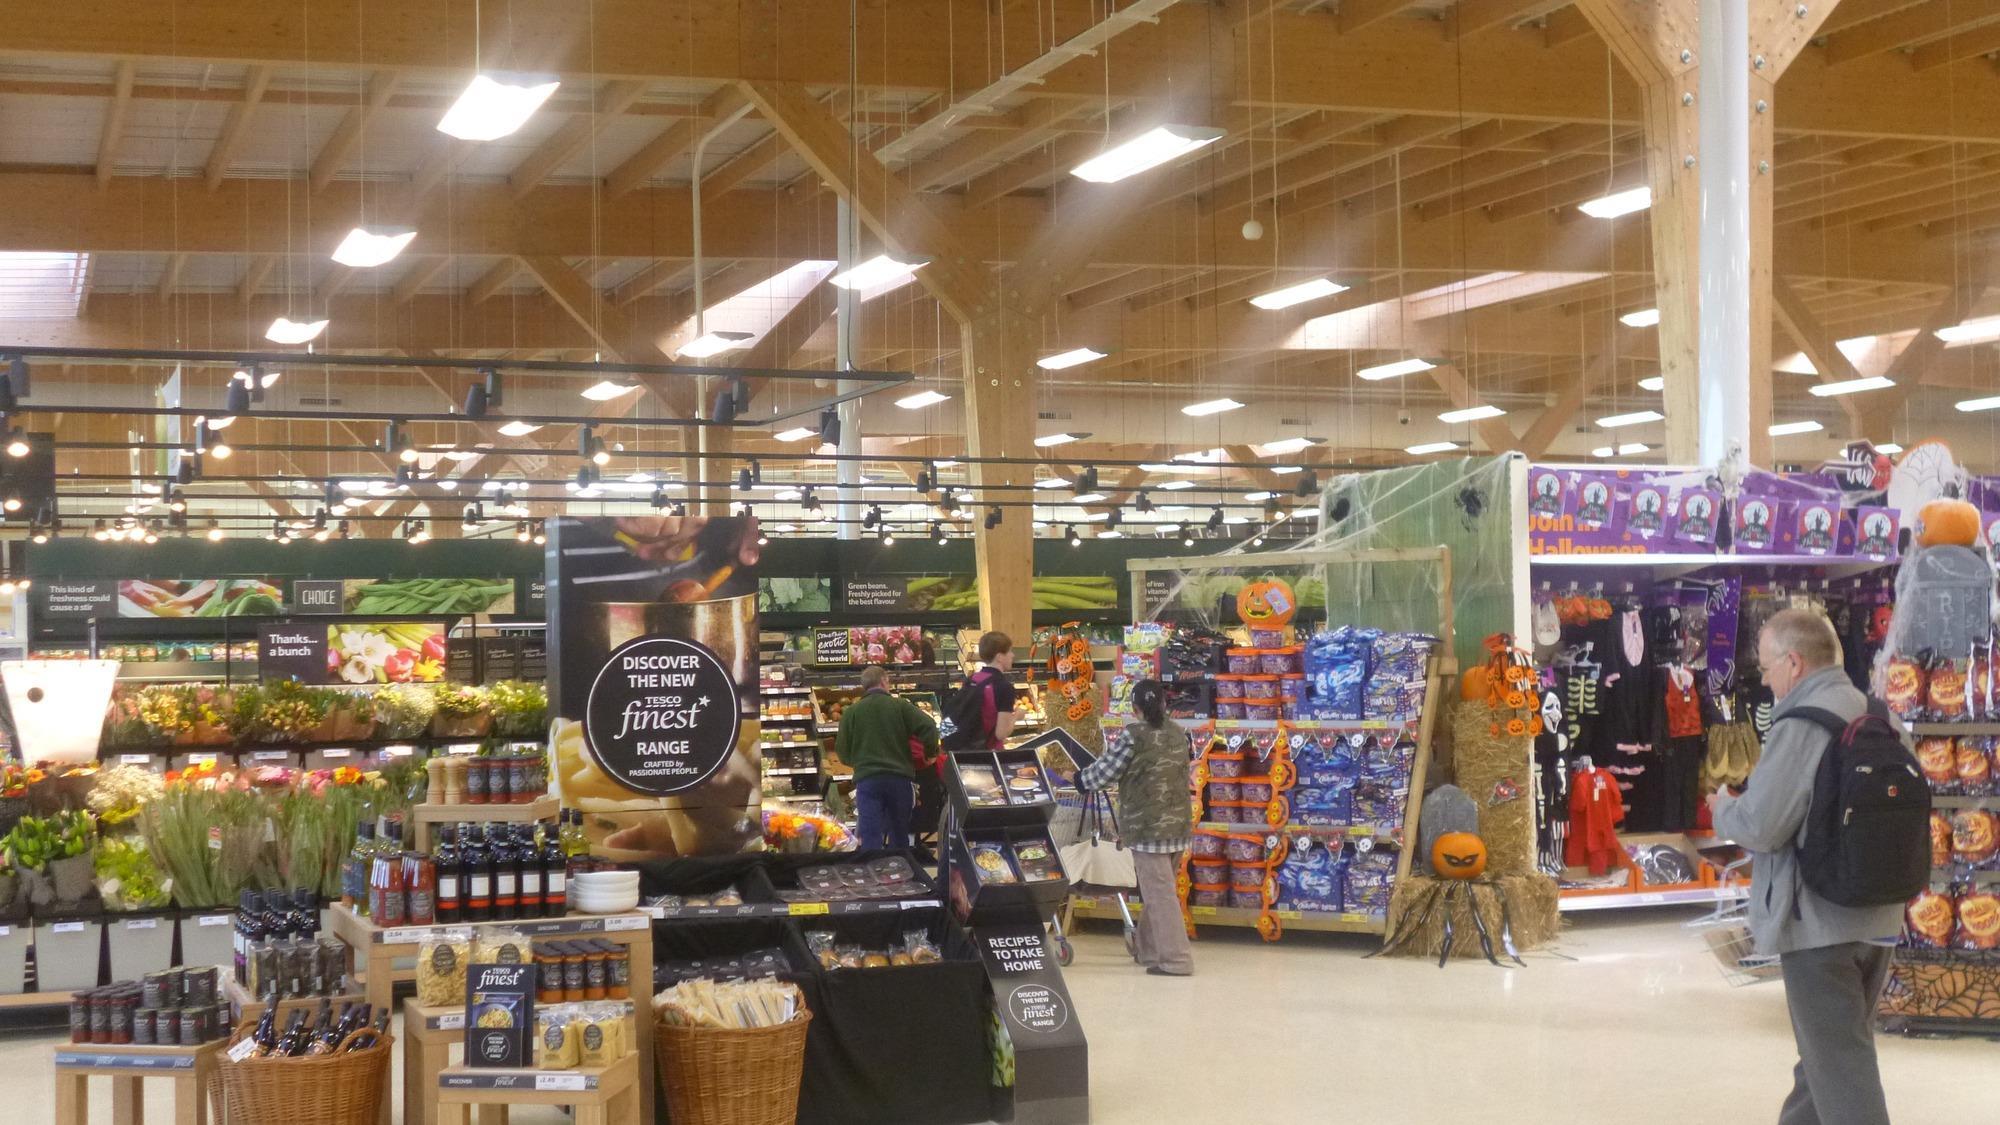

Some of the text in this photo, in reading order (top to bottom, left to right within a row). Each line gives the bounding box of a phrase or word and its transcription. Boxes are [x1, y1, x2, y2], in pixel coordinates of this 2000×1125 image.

[49, 585, 96, 594] This kind of
[848, 582, 889, 590] Green beans.
[49, 594, 111, 603] freshness could
[302, 589, 336, 605] CHOICE
[848, 590, 871, 598] Freshly
[871, 590, 892, 598] picked
[49, 604, 73, 612] cause
[268, 633, 318, 645] Thanks...
[817, 631, 848, 640] something
[818, 637, 848, 650] exotic
[269, 646, 312, 657] a bunch
[623, 655, 700, 670] DISCOVER
[627, 673, 696, 688] THE NEW
[644, 695, 682, 706] TESCO
[613, 700, 702, 740] finest
[636, 740, 690, 756] RANGE
[643, 760, 684, 769] CRAFTED by
[629, 767, 698, 777] PASSIONATE PEOPLE
[988, 936, 1041, 948] RECIPES
[993, 947, 1046, 960] TO TAKE
[1003, 960, 1044, 972] HOME
[476, 969, 520, 990] finest
[1017, 990, 1049, 999] DISCOVER
[1022, 1007, 1055, 1022] finest
[1032, 1019, 1055, 1027] RANGE
